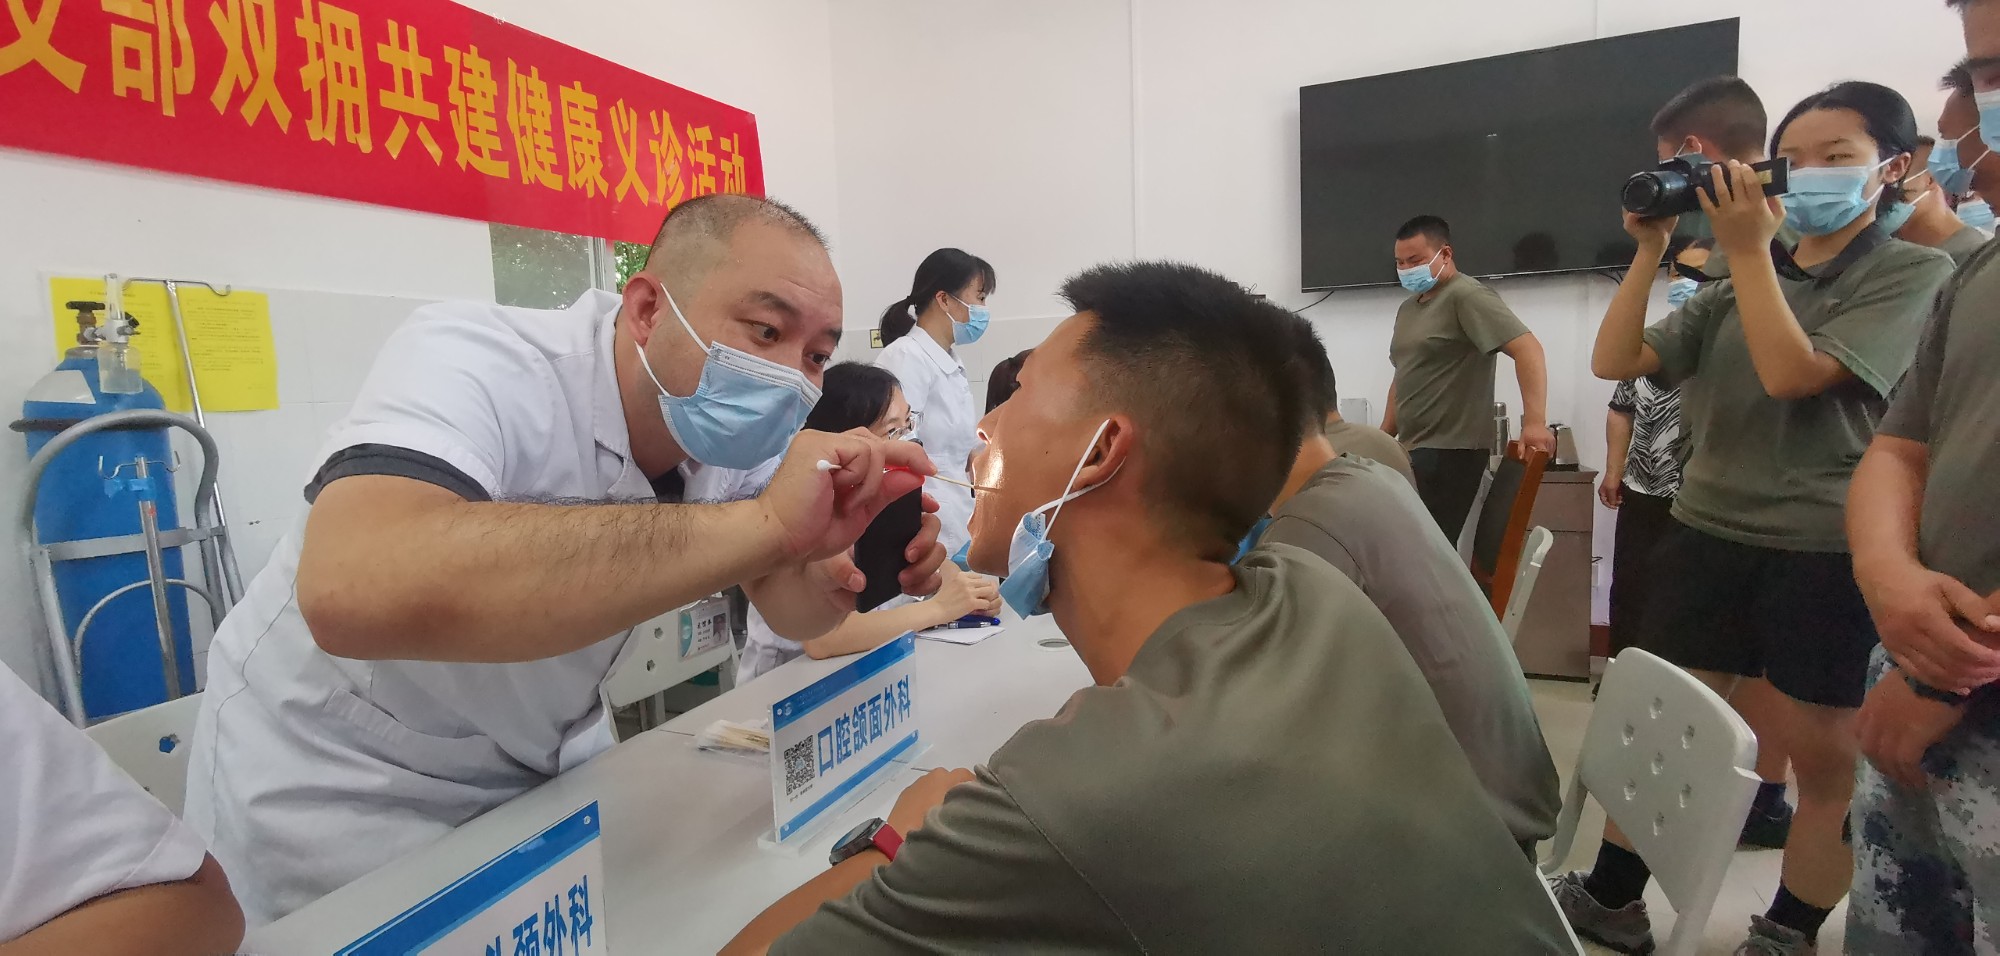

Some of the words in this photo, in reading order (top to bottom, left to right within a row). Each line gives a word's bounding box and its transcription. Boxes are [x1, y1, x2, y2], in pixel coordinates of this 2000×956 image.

[817, 674, 911, 777] 口腔颌面外科
[485, 874, 593, 956] 颈外科
